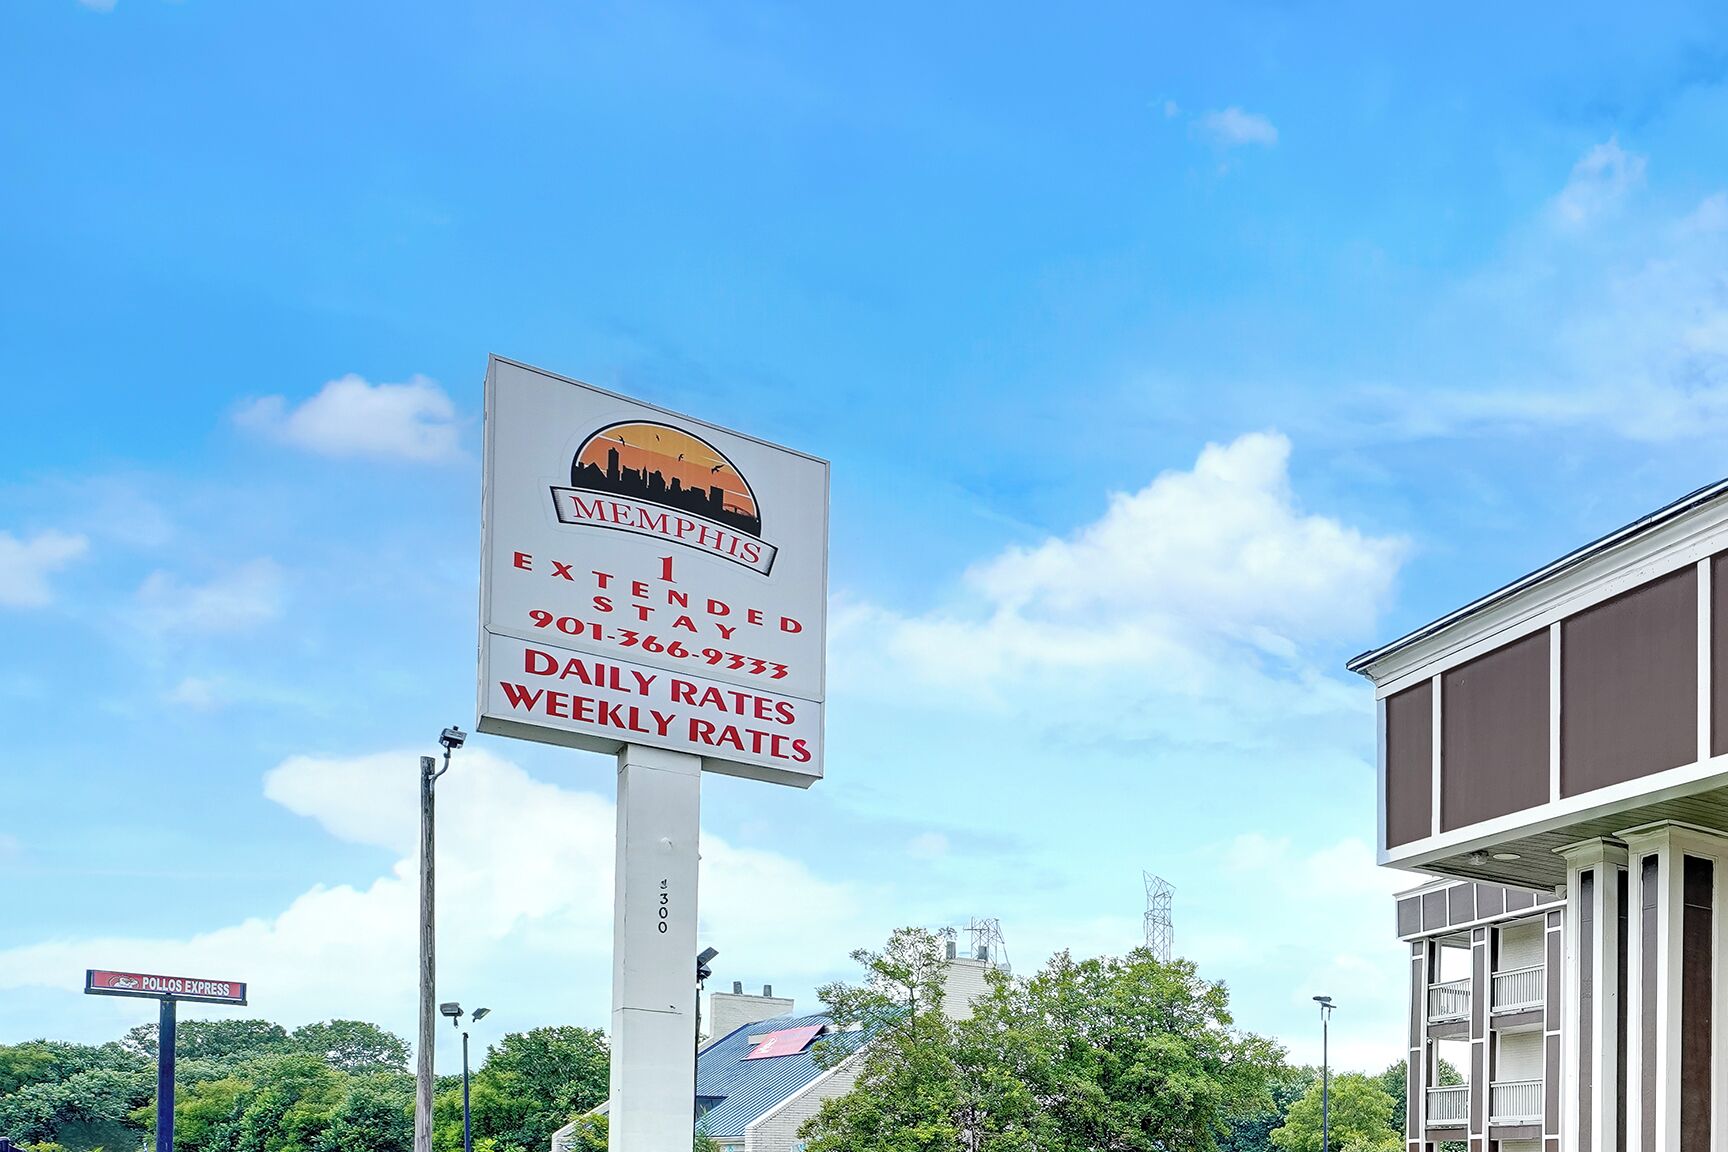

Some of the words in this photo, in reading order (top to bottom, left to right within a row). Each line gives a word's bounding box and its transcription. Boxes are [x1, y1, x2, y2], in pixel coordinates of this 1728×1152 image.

[569, 494, 761, 564] MEMPHIS
[513, 551, 803, 635] EXTENDED
[656, 555, 677, 584] 1
[529, 609, 790, 681] 901-366-9333
[592, 595, 737, 641] STAY
[500, 681, 676, 737] WEEKLY
[688, 717, 812, 764] RATES
[524, 648, 658, 697] DAILY
[670, 679, 796, 726] RATES
[142, 976, 182, 992] POLLOS
[185, 981, 230, 996] EXPRESS
